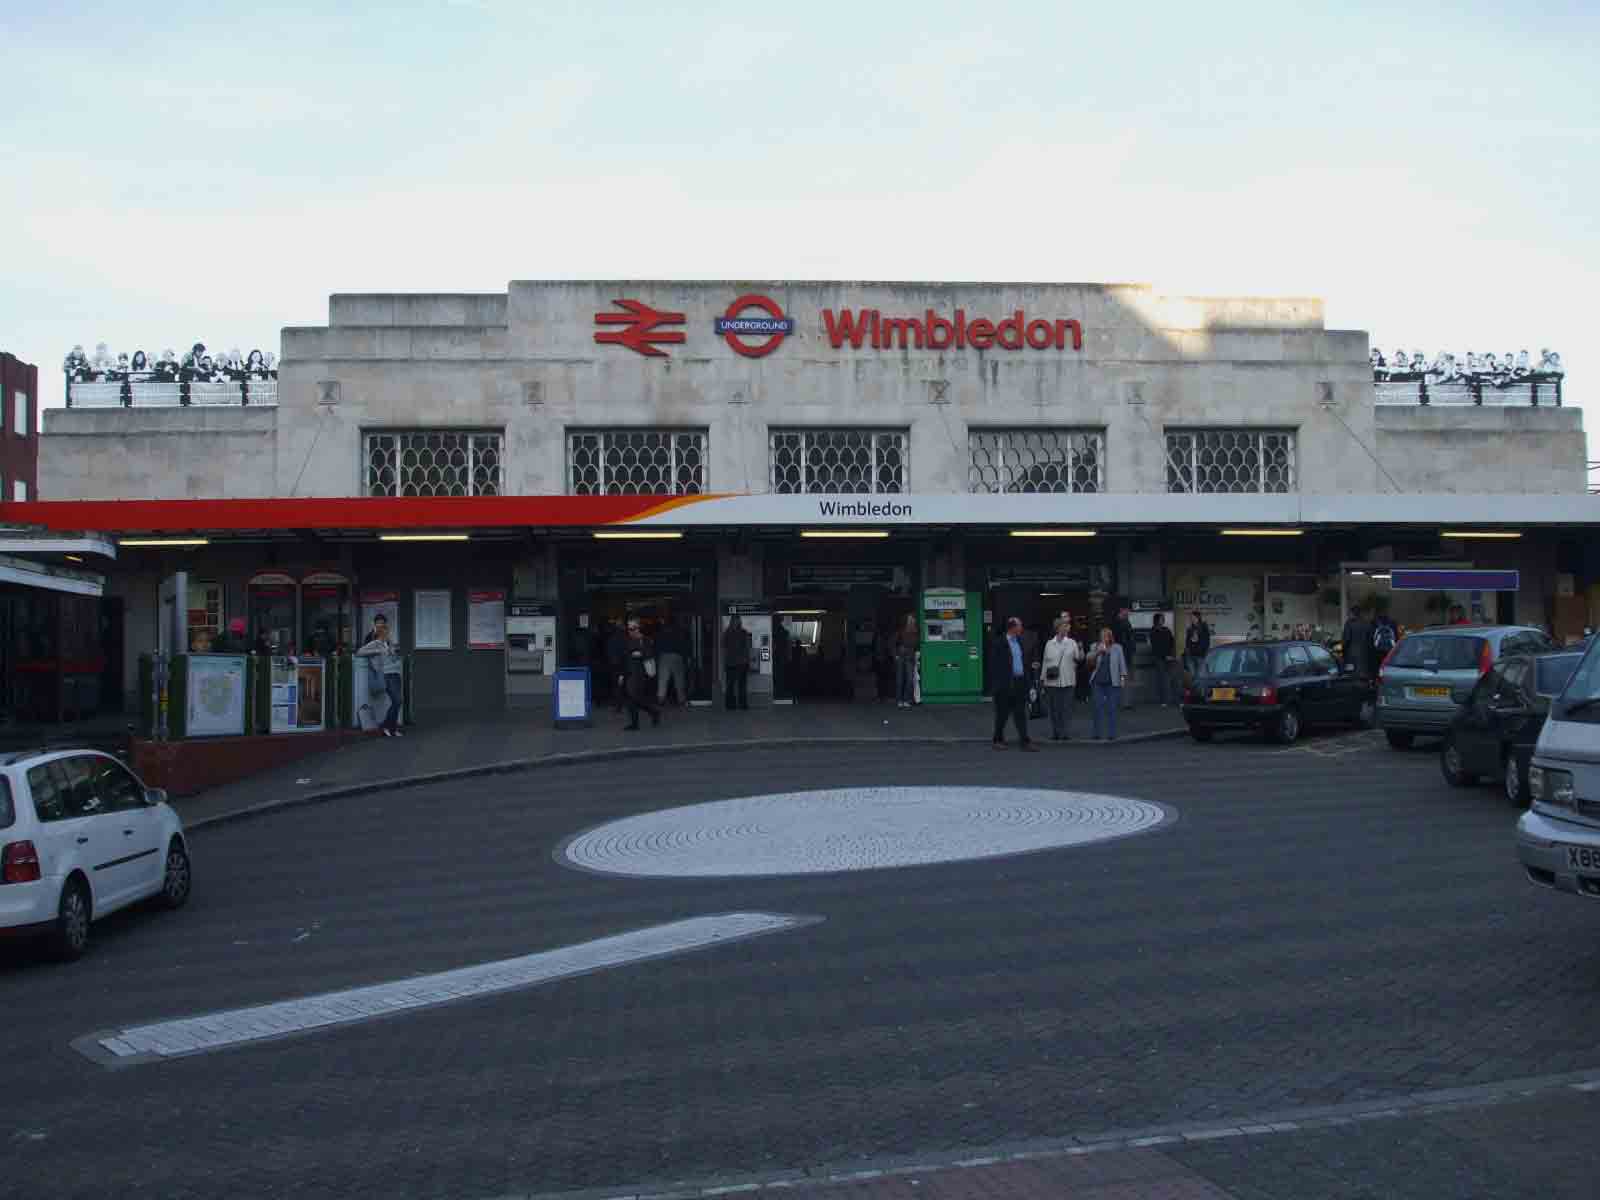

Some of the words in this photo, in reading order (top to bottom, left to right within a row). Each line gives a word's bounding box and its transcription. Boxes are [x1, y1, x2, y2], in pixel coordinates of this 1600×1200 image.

[721, 321, 788, 329] UNDERGROUND
[822, 308, 1082, 351] Wimbledon
[820, 501, 912, 516] Wimbledon
